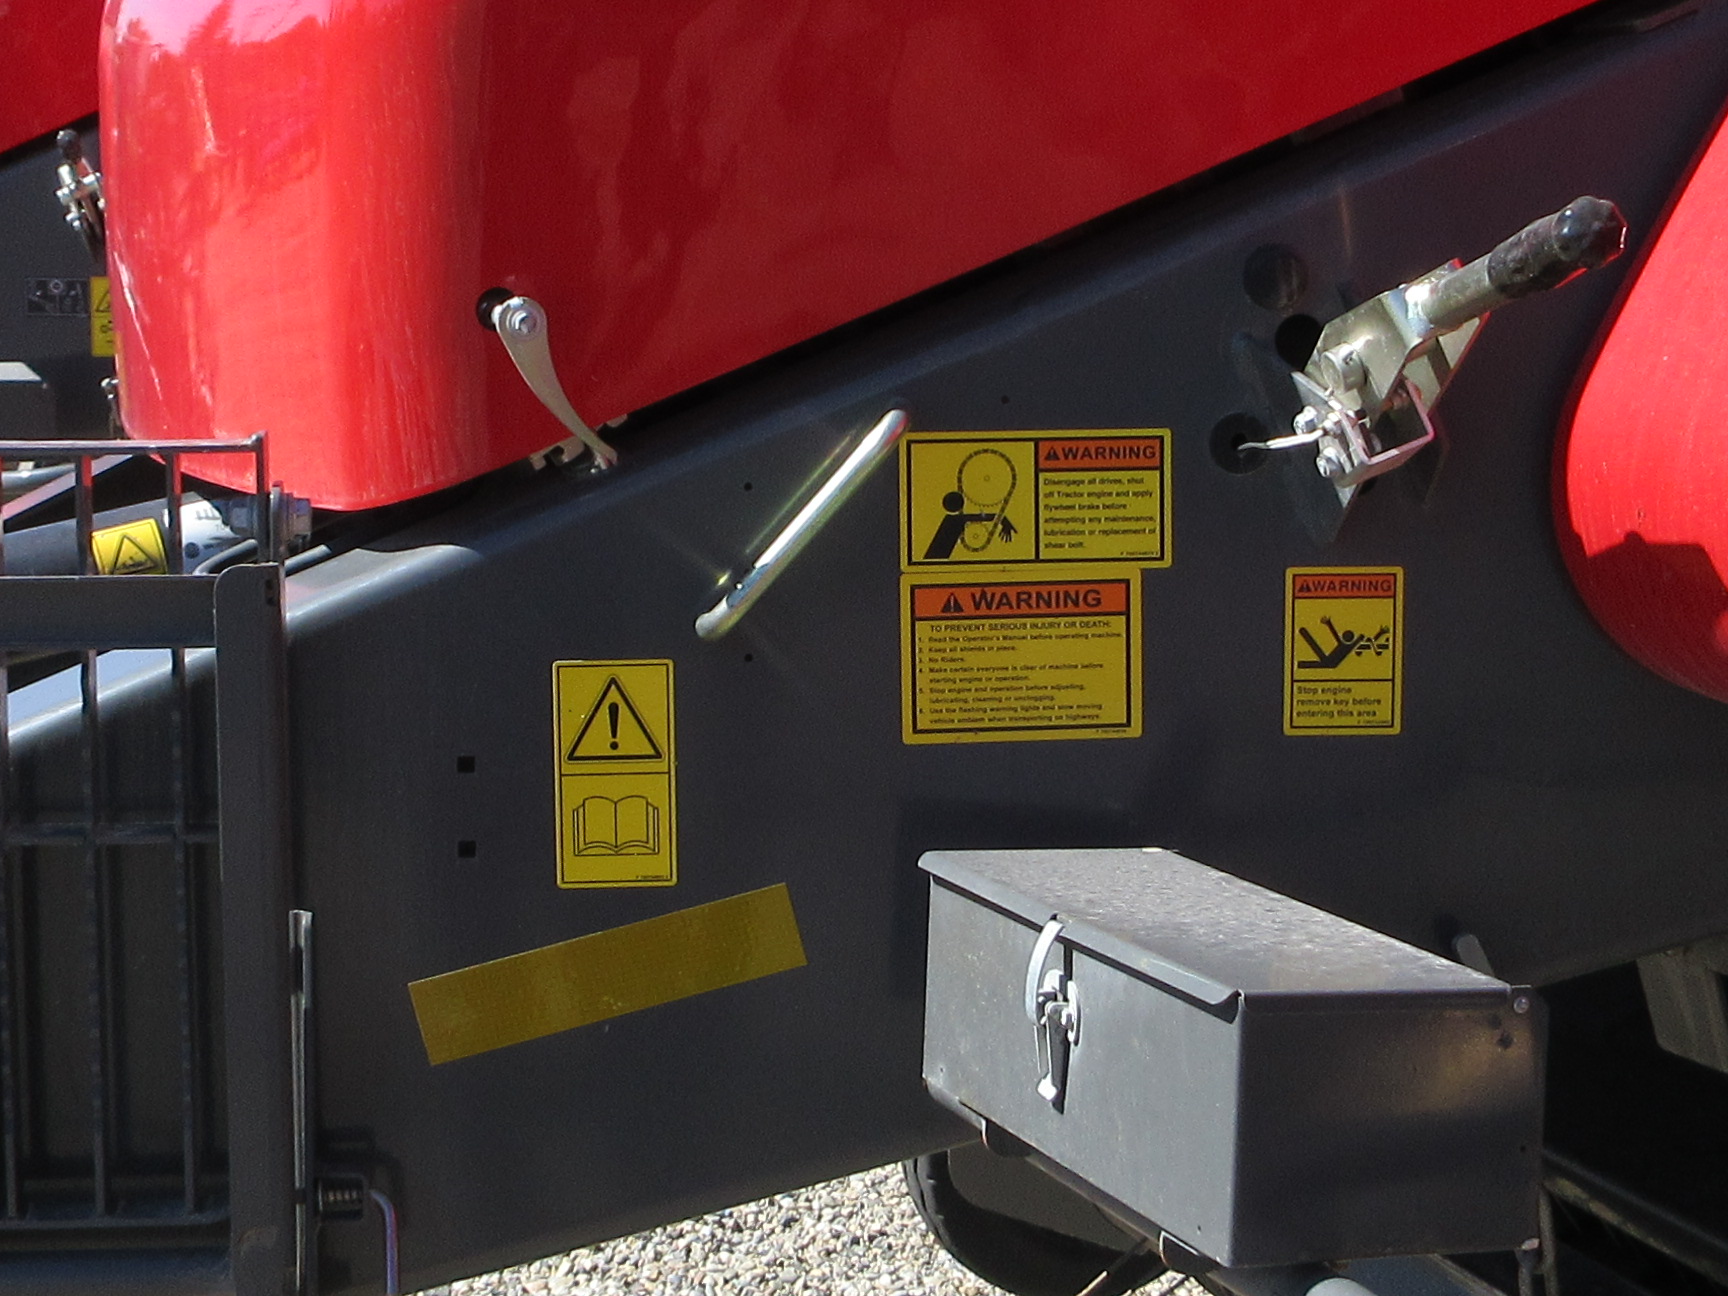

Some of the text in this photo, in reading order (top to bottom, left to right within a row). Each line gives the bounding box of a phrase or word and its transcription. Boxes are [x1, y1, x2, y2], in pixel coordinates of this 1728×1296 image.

[1061, 445, 1156, 461] WARNING
[1312, 580, 1392, 593] WARNING
[971, 588, 1102, 611] WARNING
[944, 624, 985, 632] PREVENT
[988, 623, 1028, 631] SERIOUS
[1030, 622, 1061, 630] INJURY
[1079, 620, 1111, 628] DEATH:
[1297, 686, 1352, 696] Stop engine
[1296, 698, 1382, 706] remove key before
[1296, 709, 1334, 719] entering
[1337, 709, 1354, 717] this
